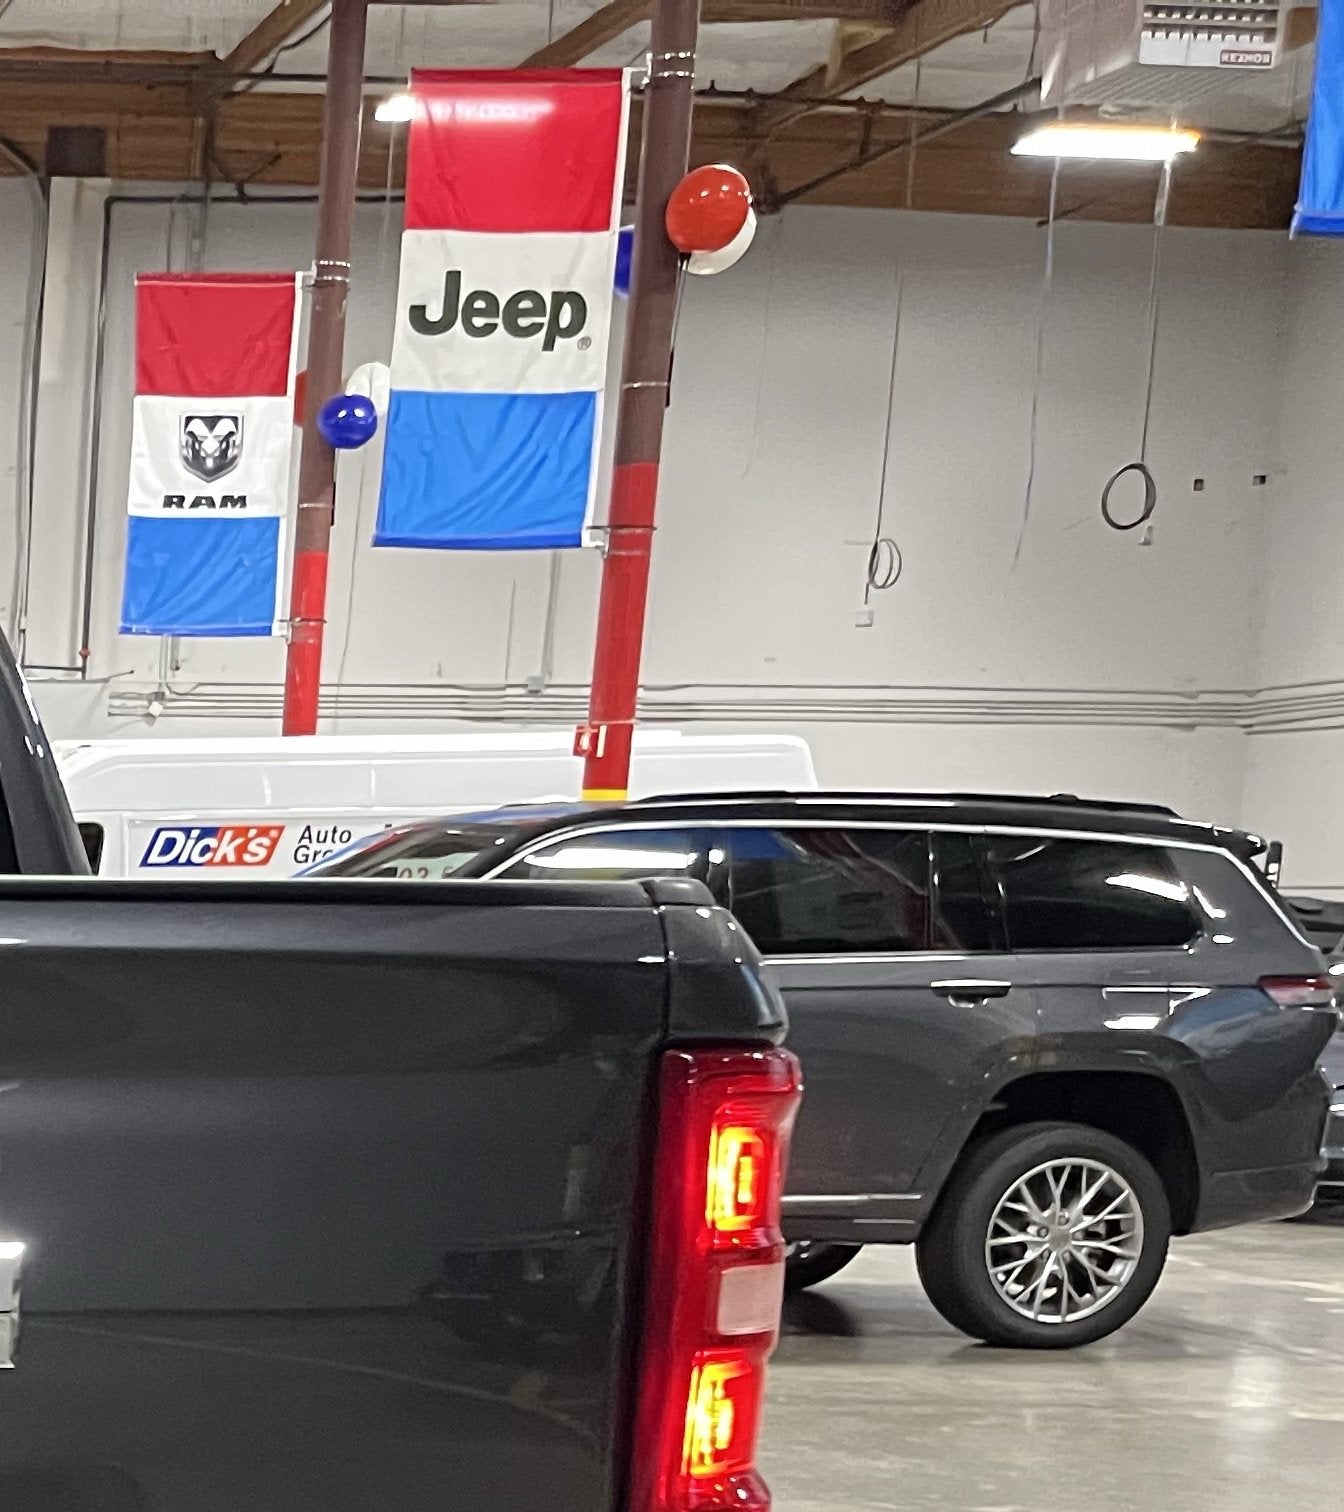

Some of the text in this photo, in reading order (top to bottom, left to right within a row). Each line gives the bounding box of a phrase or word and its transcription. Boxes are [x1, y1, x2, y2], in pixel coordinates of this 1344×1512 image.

[409, 270, 588, 352] Jeep
[162, 494, 248, 509] RAM
[146, 825, 352, 865] Dick's Auto
